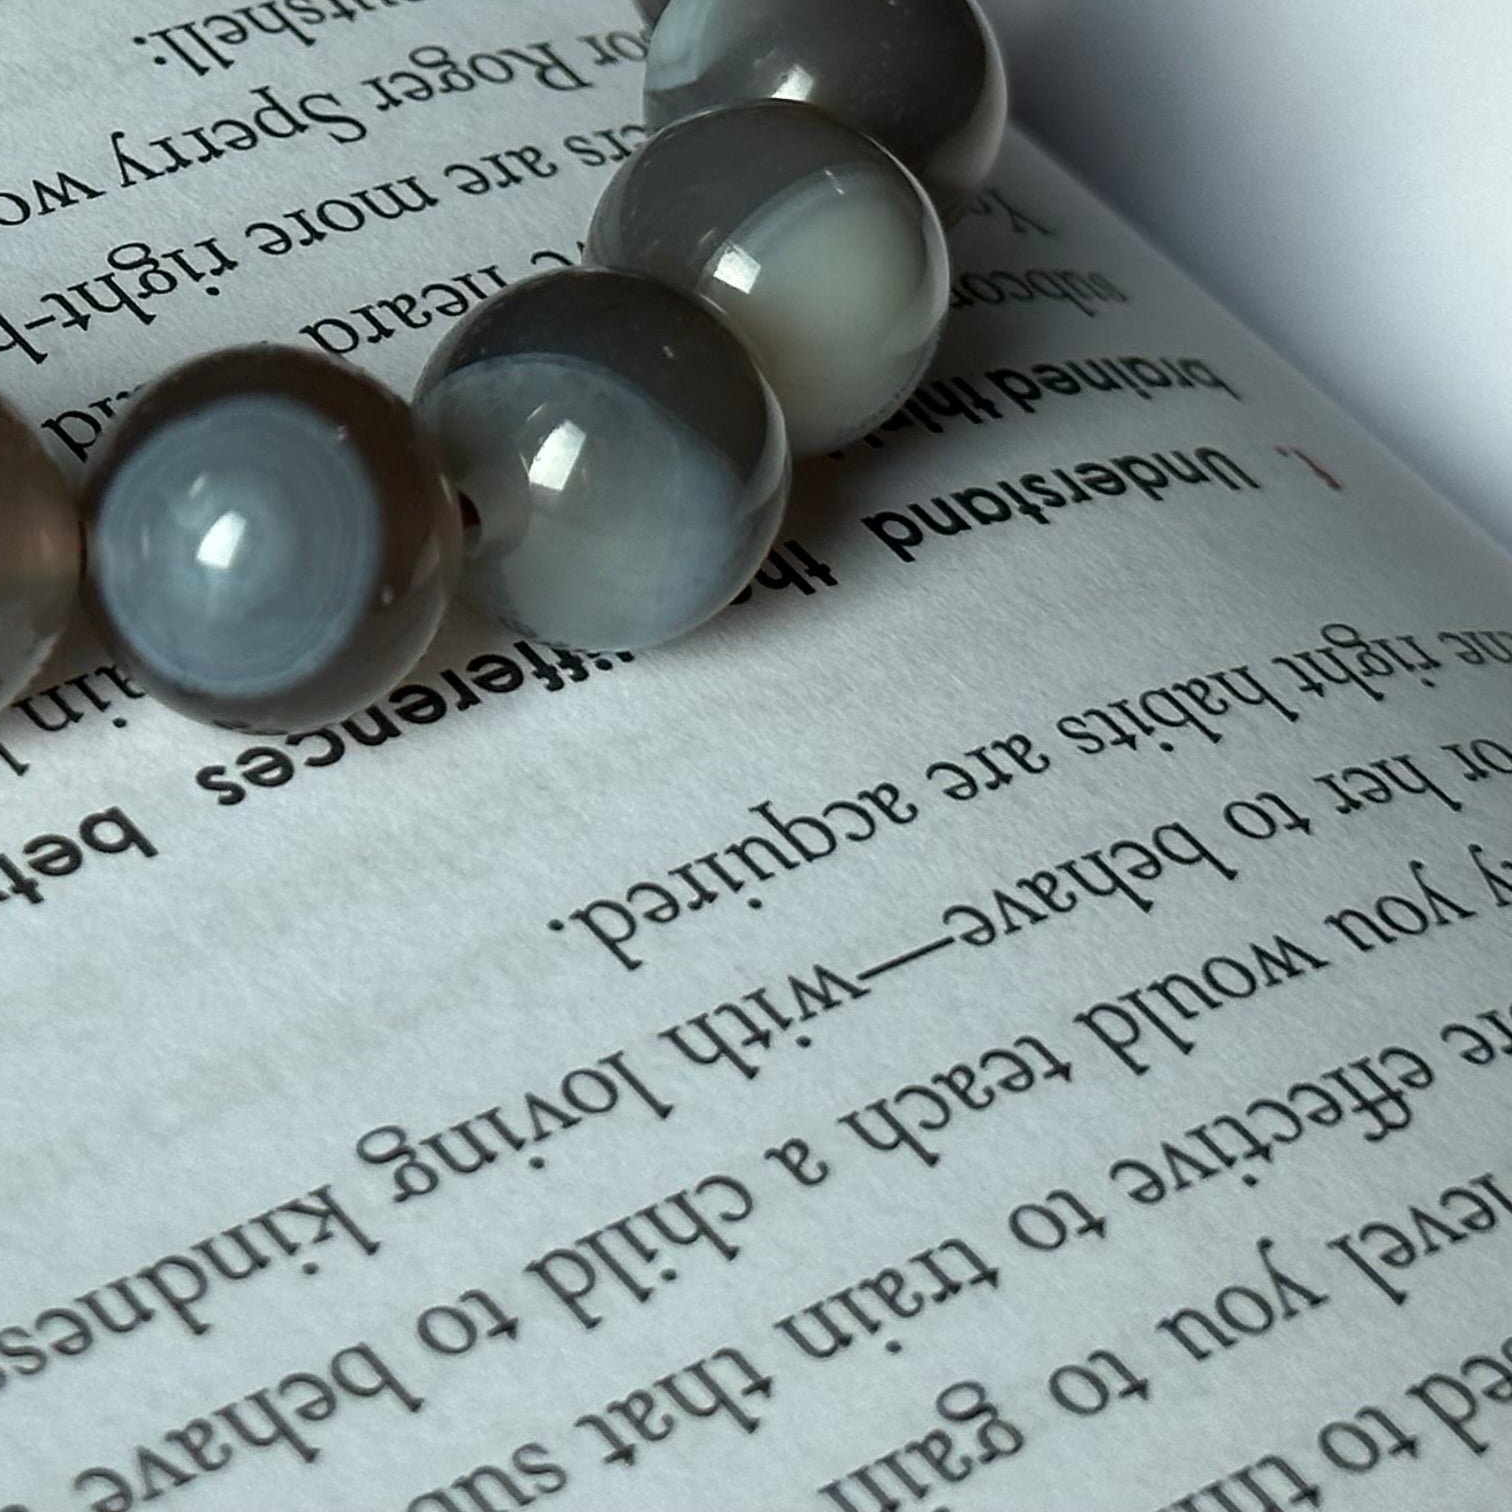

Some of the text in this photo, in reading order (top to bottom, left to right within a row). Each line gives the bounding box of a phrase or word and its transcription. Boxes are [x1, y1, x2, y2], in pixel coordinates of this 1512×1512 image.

[360, 44, 595, 113] Roger
[108, 84, 369, 188] Sperry
[442, 144, 559, 196] are
[243, 173, 440, 263] more
[985, 357, 1242, 413] brained
[860, 446, 1261, 563] Understand
[727, 539, 838, 606] th
[546, 622, 1441, 971] right habits are acquired.
[1222, 791, 1312, 837] to
[1312, 754, 1462, 812] her
[354, 1048, 673, 1203] loving
[1109, 1046, 1434, 1210] effective
[72, 860, 1476, 1512] you would teach a child to behave
[1007, 1189, 1105, 1252] to
[772, 1237, 999, 1354] train
[1156, 1238, 1329, 1360] you
[574, 1347, 773, 1468] that
[1048, 1349, 1148, 1419] to
[816, 1380, 1024, 1512] gain
[1317, 1407, 1418, 1475] to
